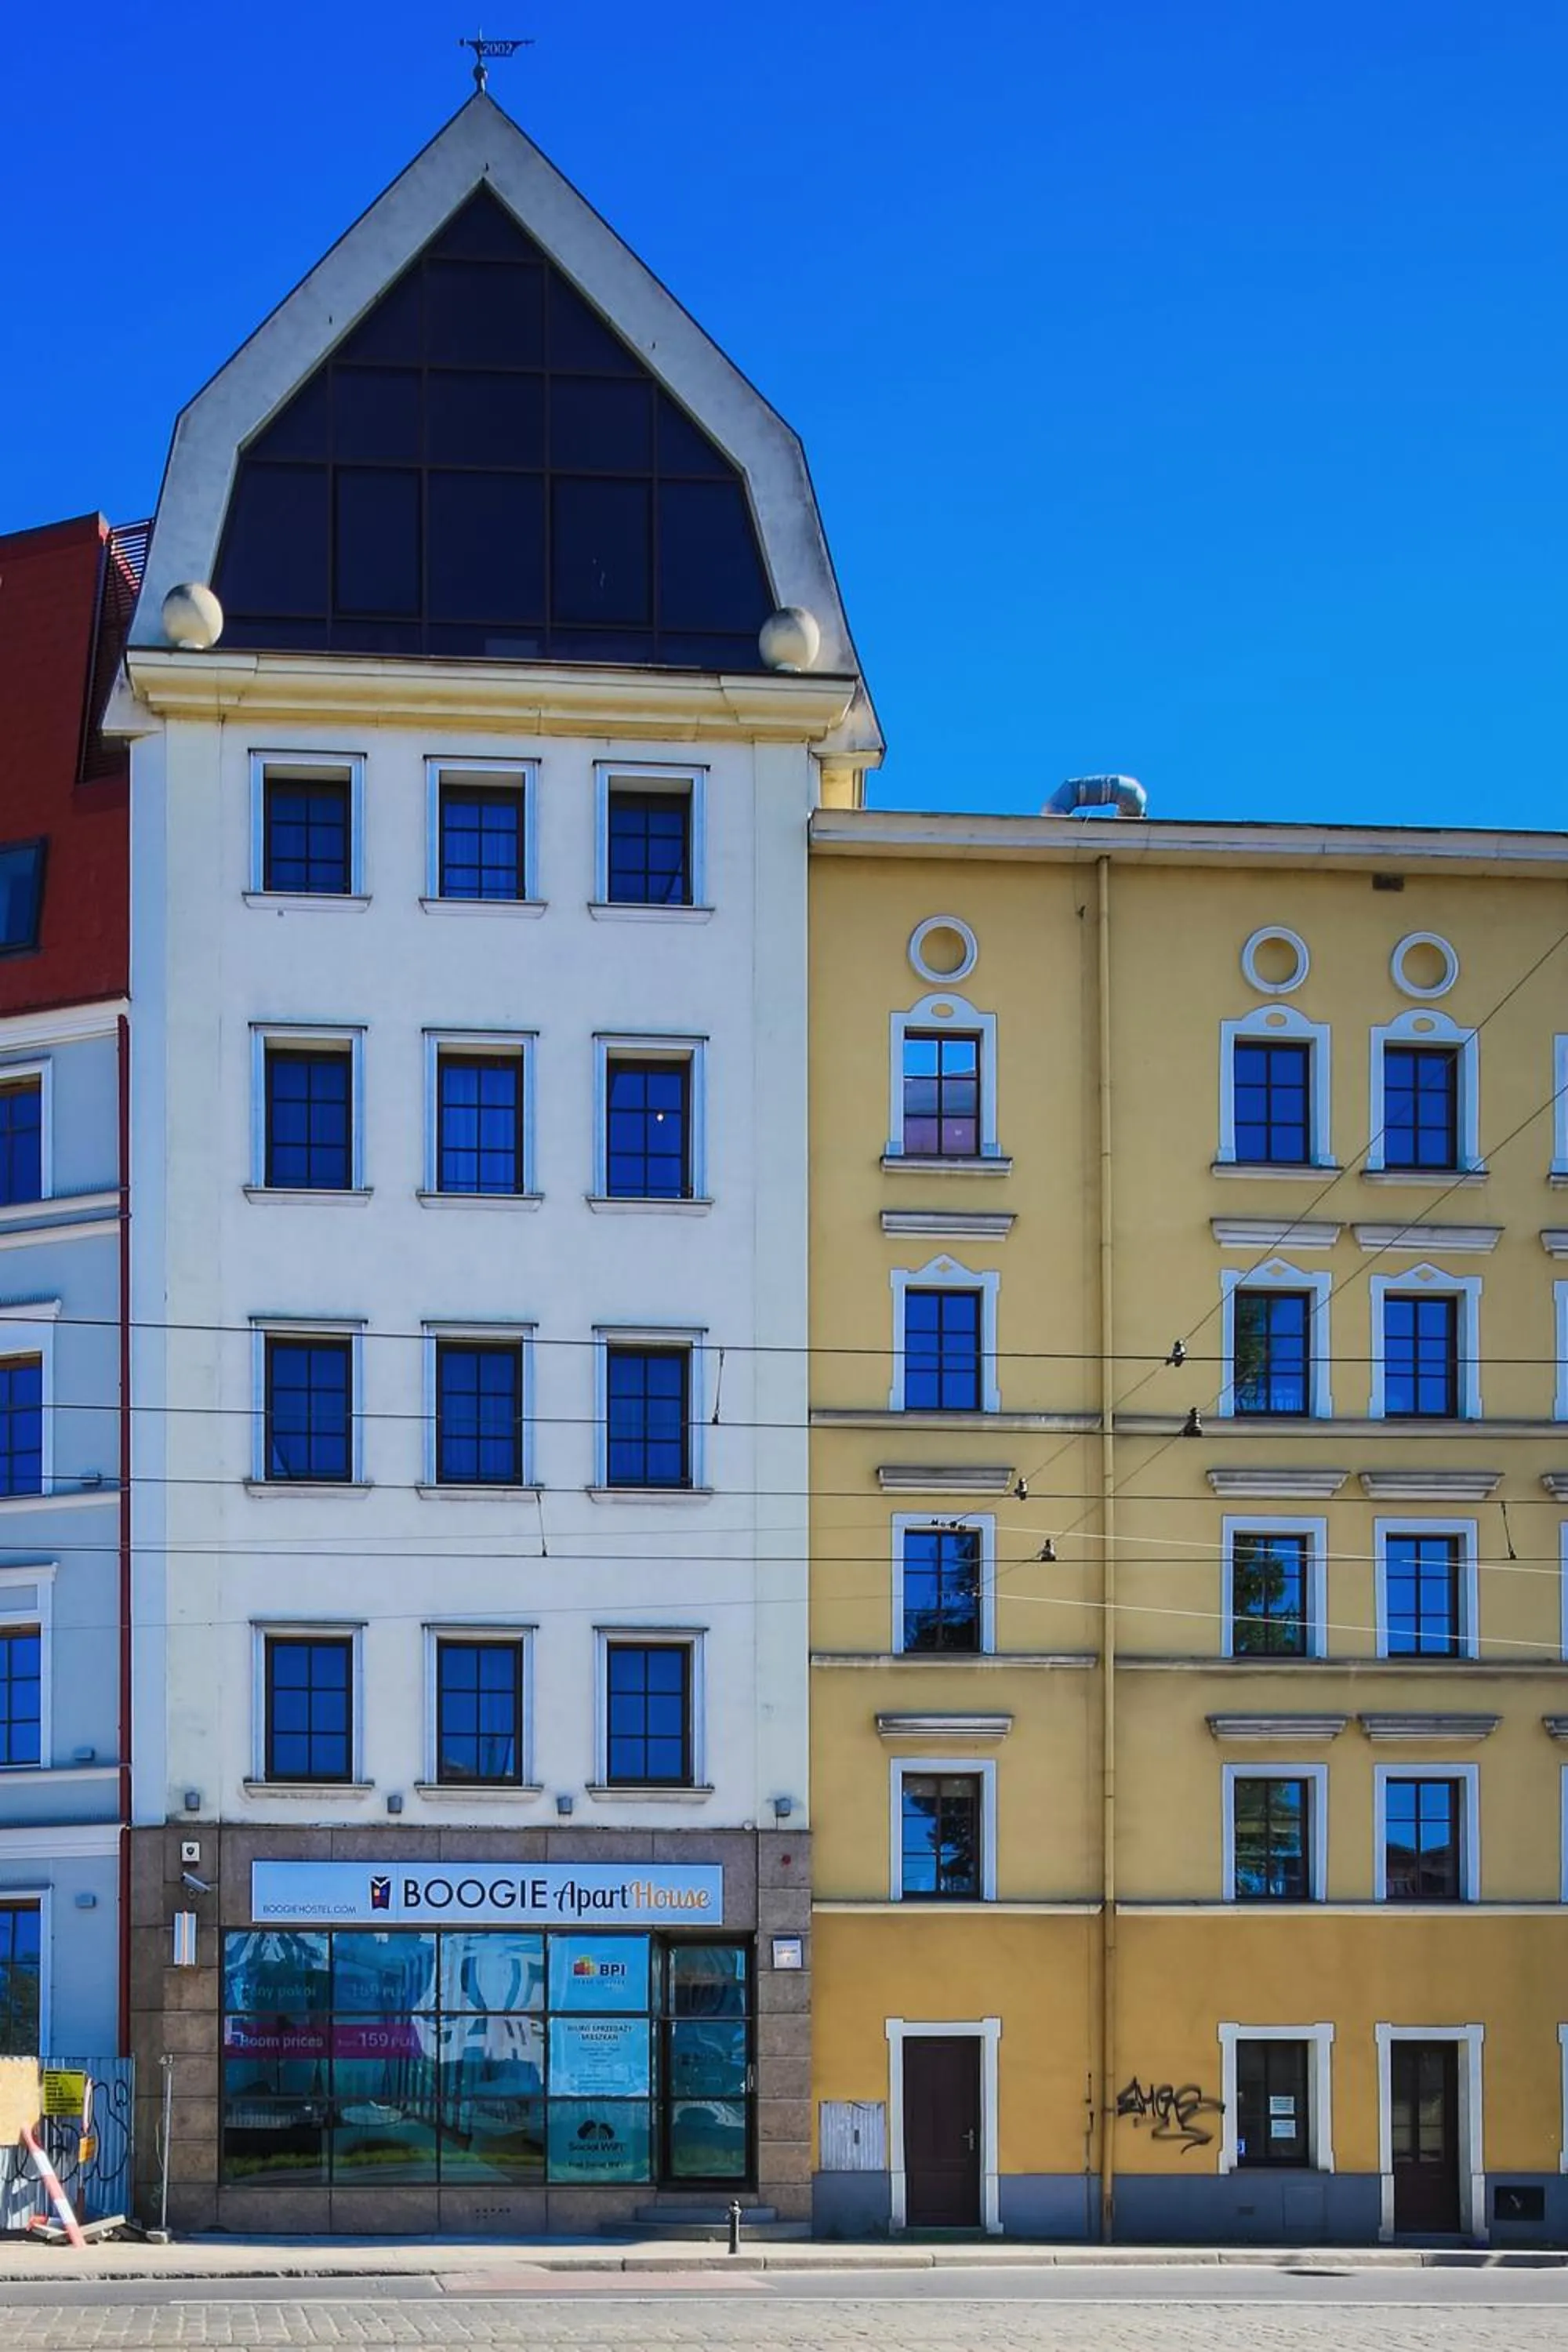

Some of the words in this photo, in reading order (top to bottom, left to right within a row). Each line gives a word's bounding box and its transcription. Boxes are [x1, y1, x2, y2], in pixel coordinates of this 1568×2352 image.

[482, 43, 513, 54] 2002
[403, 1879, 547, 1908] BOOGIE
[599, 1964, 626, 1976] BPI
[239, 2032, 279, 2047] Room
[282, 2032, 324, 2049] prices
[359, 2032, 389, 2047] 159
